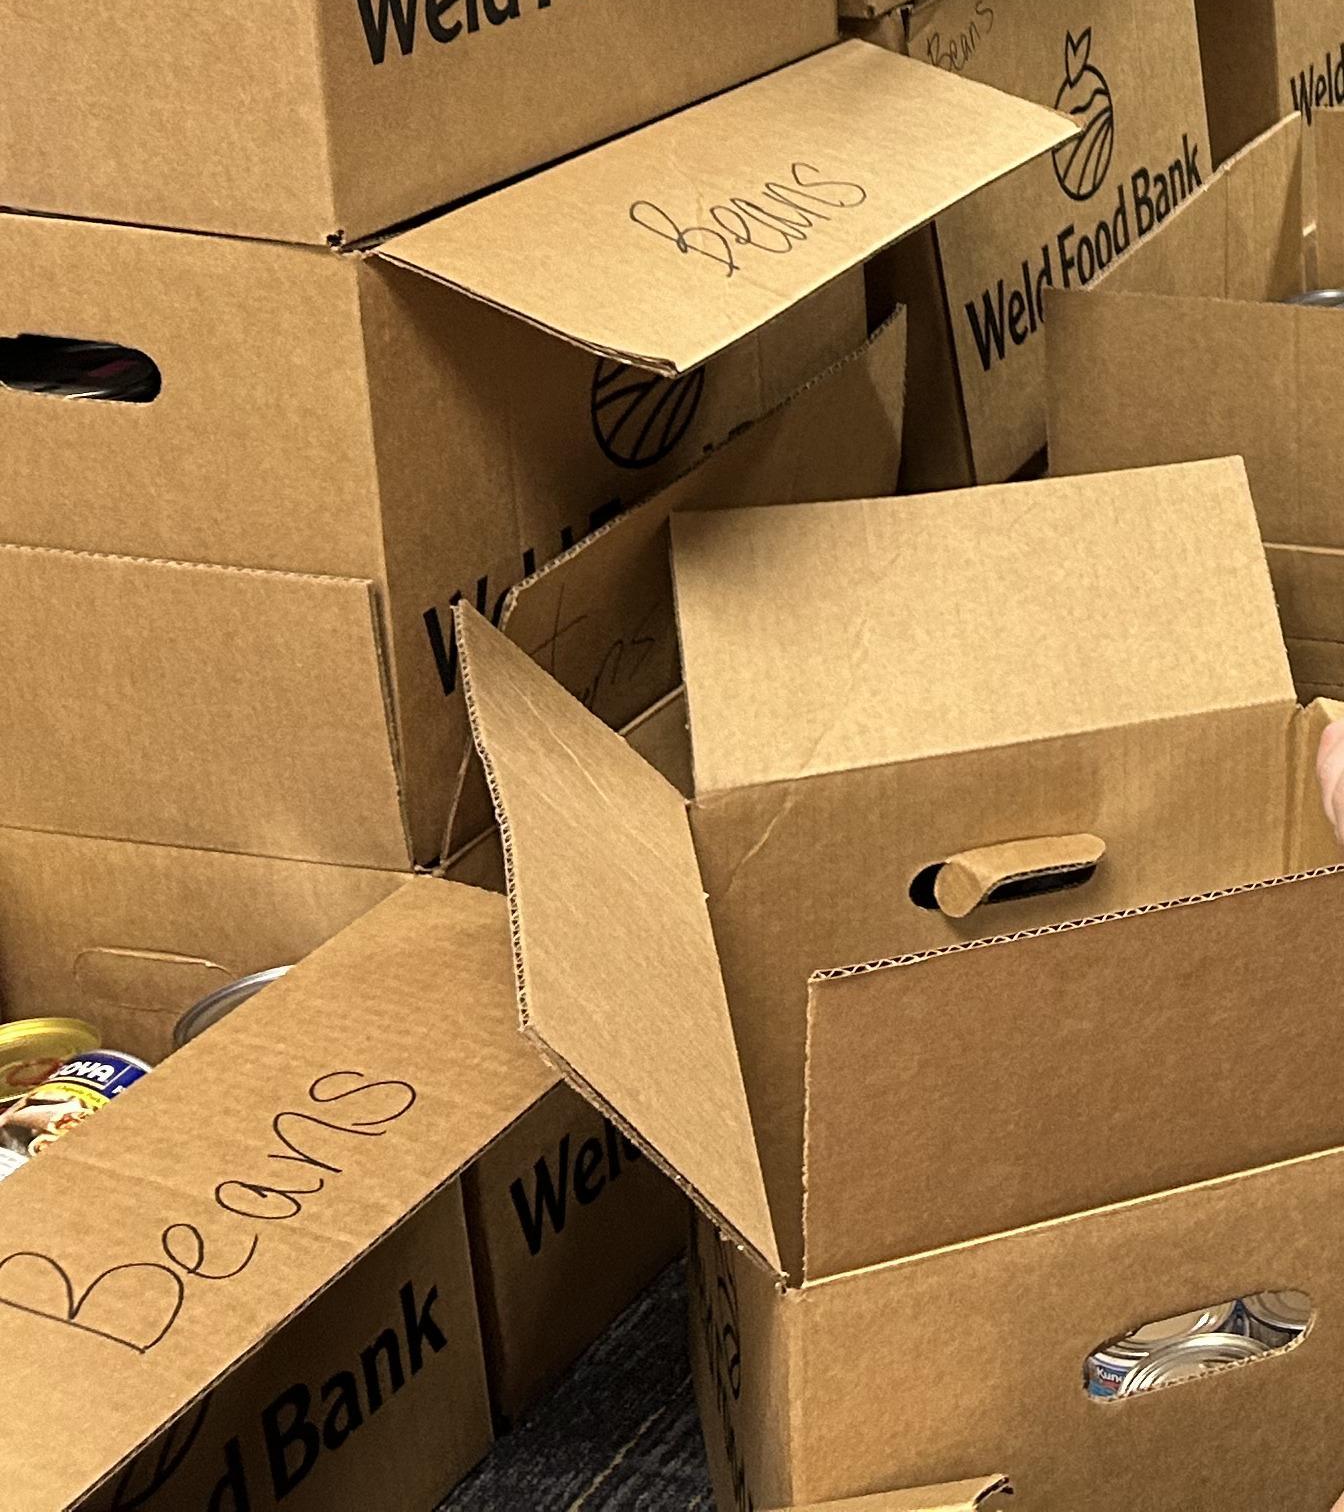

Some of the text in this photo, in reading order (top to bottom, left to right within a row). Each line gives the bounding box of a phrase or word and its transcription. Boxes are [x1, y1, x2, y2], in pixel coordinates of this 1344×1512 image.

[628, 161, 868, 279] Beans
[965, 133, 1202, 373] Weld Food Bank
[56, 1060, 115, 1083] OYA
[0, 1070, 417, 1354] Beans
[508, 1115, 642, 1257] Wel
[259, 1278, 449, 1496] Bank
